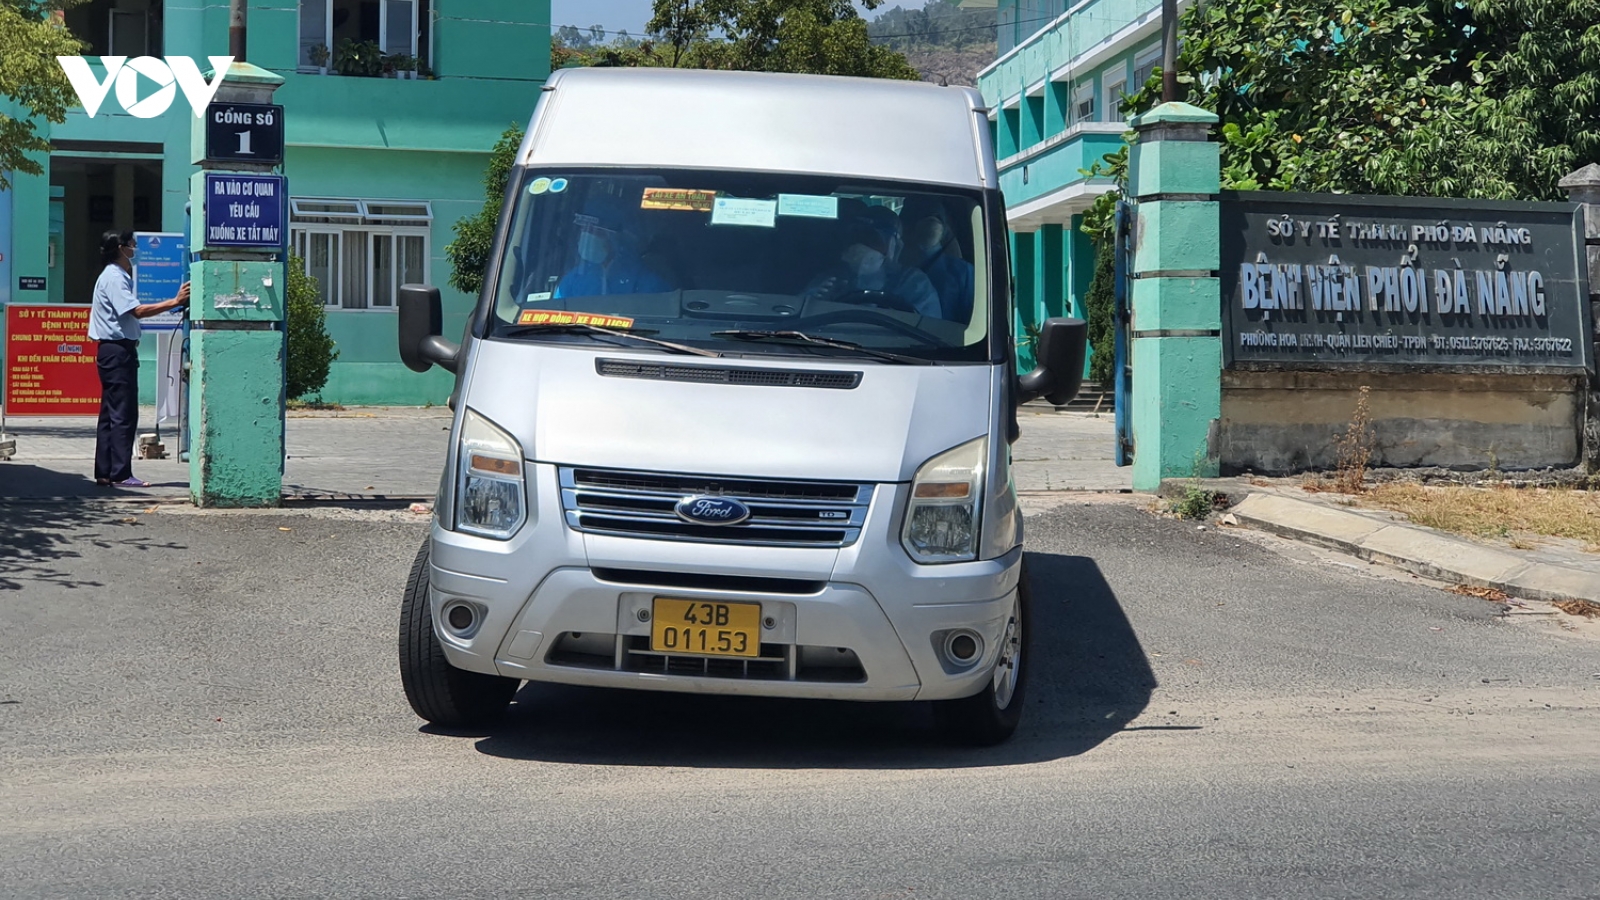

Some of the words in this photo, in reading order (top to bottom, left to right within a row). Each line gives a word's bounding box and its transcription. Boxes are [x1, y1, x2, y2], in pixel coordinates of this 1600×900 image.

[215, 107, 252, 124] CỔNG
[256, 109, 274, 125] SỐ
[234, 130, 255, 154] 1
[214, 181, 225, 195] RA
[226, 179, 241, 195] VÀO
[242, 181, 253, 195] CƠ
[254, 182, 274, 197] QUAN
[229, 201, 243, 217] YÊU
[210, 222, 235, 240] XUỐNG
[236, 226, 246, 240] XE
[247, 222, 261, 240] TẮT
[262, 225, 278, 241] MÁY
[1266, 214, 1293, 238] SỞ
[1297, 220, 1311, 238] Y
[1316, 214, 1341, 239] TẾ
[1411, 219, 1450, 242] PHỐ
[1452, 222, 1477, 243] ĐÀ
[1481, 221, 1531, 245] NẴNG
[1240, 252, 1304, 321] BỆNH
[1305, 254, 1361, 322] VIỆN
[1365, 244, 1428, 313] PHỔI
[1434, 257, 1471, 314] ĐÀ
[1476, 253, 1546, 316] NẴNG
[37, 310, 46, 318] TẾ
[47, 310, 71, 319] THÀNH
[73, 310, 88, 319] PHỐ
[521, 313, 531, 322] XE
[576, 315, 590, 324] XE
[42, 322, 61, 330] BỆNH
[63, 322, 80, 331] VIỆN
[692, 499, 732, 518] Ford
[684, 603, 729, 626] 43B
[664, 627, 748, 652] 011.53
